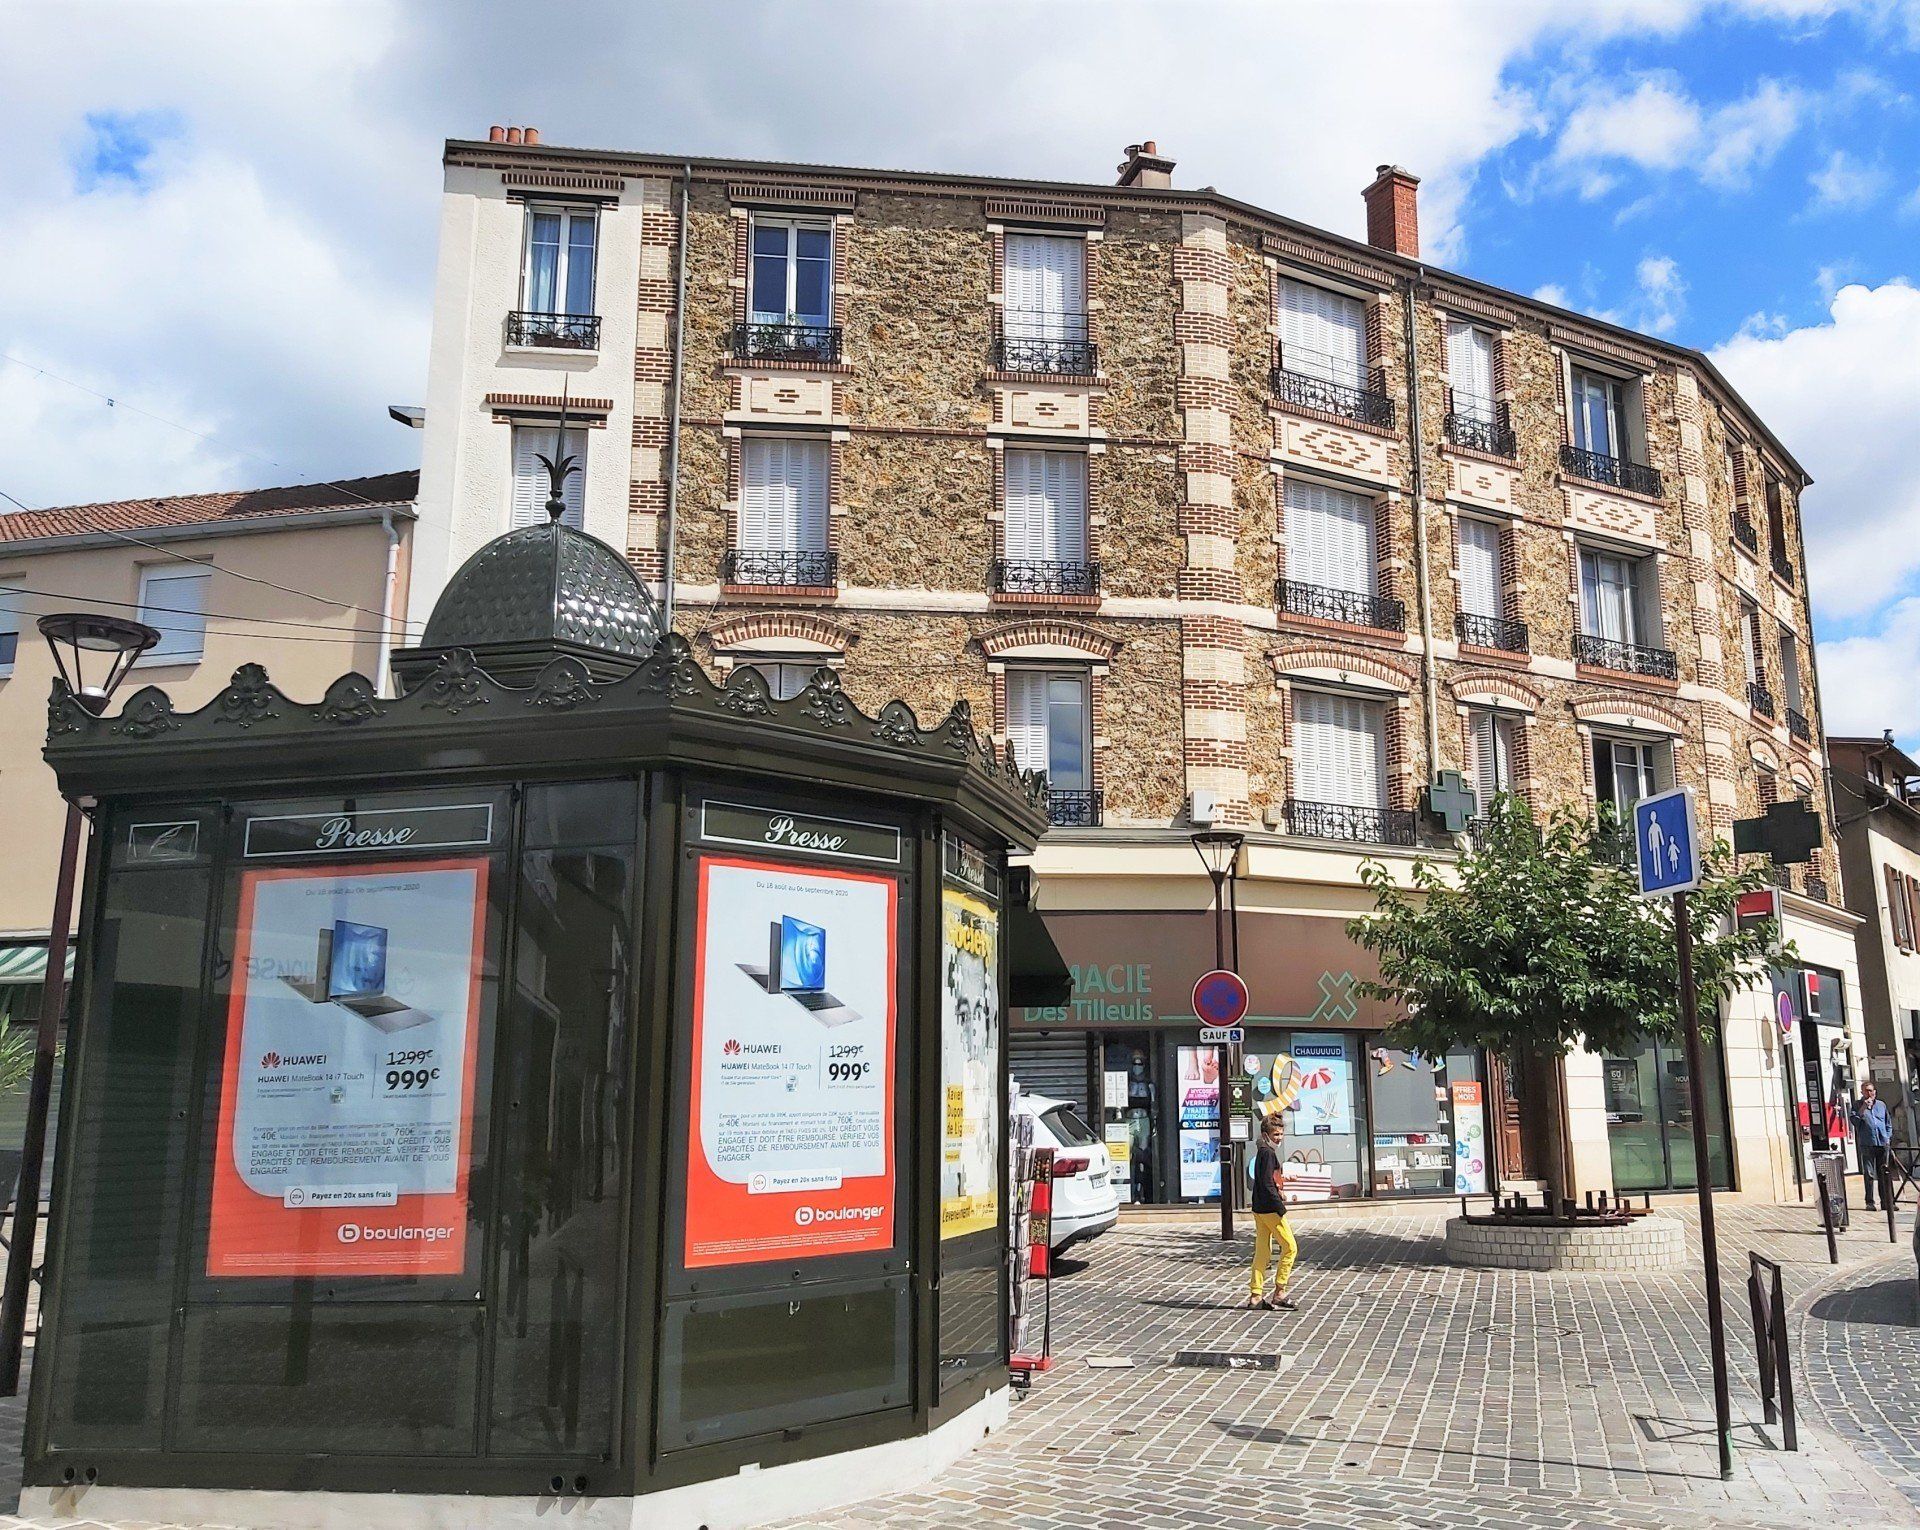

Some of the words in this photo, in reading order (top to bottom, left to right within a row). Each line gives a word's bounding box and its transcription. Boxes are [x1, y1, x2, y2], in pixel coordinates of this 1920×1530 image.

[316, 817, 418, 848] Presse
[765, 815, 848, 850] Presse
[805, 887, 834, 895] septembre
[1024, 1006, 1067, 1022] Des
[1071, 998, 1153, 1022] Tilleuls
[1202, 1031, 1227, 1040] SAUF
[743, 1044, 781, 1054] HUAWEI
[828, 1045, 864, 1058] 1299€
[283, 1054, 327, 1066] HUAWEI
[385, 1049, 434, 1067] 1299€
[721, 1062, 750, 1070] HUAWEI
[751, 1062, 780, 1070] MateBook
[796, 1062, 812, 1070] Touch
[828, 1062, 871, 1082] 999€
[258, 1075, 290, 1083] HUAWEI
[291, 1074, 324, 1083] MateBook
[342, 1072, 365, 1081] Touch
[385, 1067, 441, 1091] 999€
[726, 1118, 739, 1127] 40€
[837, 1115, 853, 1124] 760€
[260, 1131, 277, 1141] 40€
[395, 1127, 417, 1136] 760€
[829, 1125, 838, 1133] UN
[864, 1124, 879, 1132] VOUS
[383, 1138, 395, 1146] UN
[718, 1136, 747, 1144] ENGAGE
[759, 1135, 776, 1143] DOIT
[251, 1149, 284, 1157] ENGAGE
[286, 1148, 295, 1156] ET
[298, 1148, 316, 1156] DOIT
[433, 1144, 450, 1153] VOS
[758, 1144, 768, 1152] DE
[770, 1142, 829, 1151] REMBOURSEMENT
[852, 1140, 861, 1148] DE
[296, 1157, 307, 1165] DE
[310, 1155, 381, 1165] REMBOURSEMENT
[384, 1154, 410, 1162] AVANT
[412, 1154, 424, 1162] DE
[427, 1153, 450, 1162] VOUS
[773, 1178, 790, 1186] Payez
[311, 1192, 332, 1200] Payez
[375, 1190, 392, 1198] frais
[816, 1205, 886, 1221] boulanger
[363, 1225, 455, 1242] boulanger
